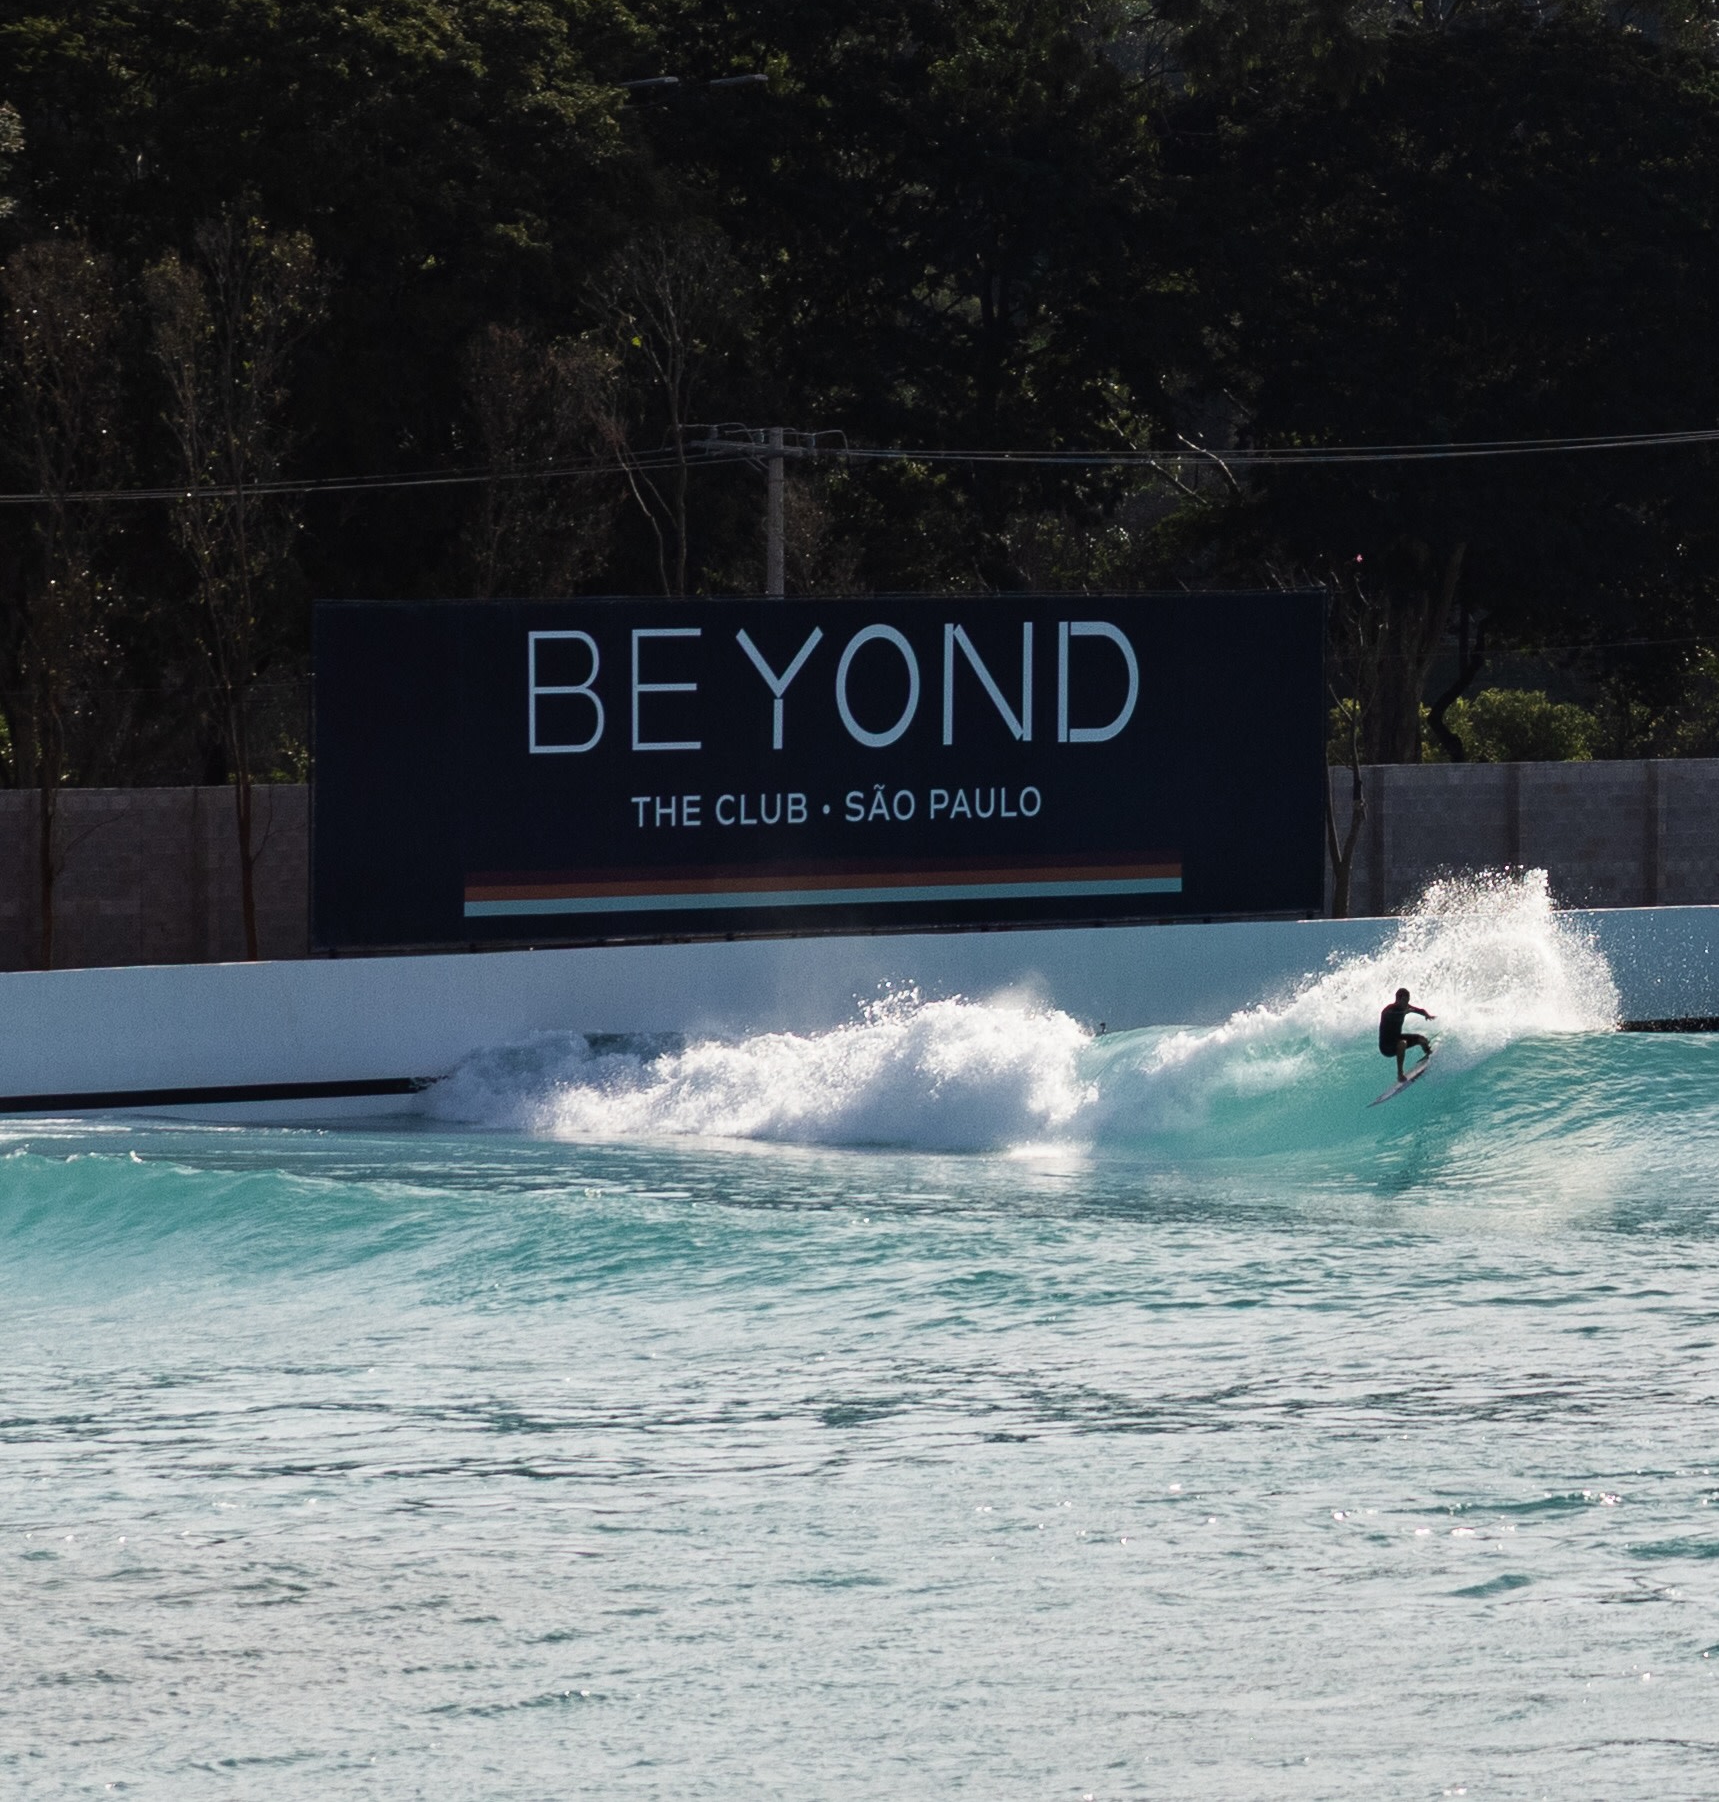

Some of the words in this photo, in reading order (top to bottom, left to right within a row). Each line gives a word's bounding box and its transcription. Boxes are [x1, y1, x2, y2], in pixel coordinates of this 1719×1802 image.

[527, 621, 1139, 754] BEYOND
[630, 795, 702, 828] THE
[715, 792, 808, 826] CLUB
[845, 783, 916, 822] SÃO
[930, 786, 1042, 820] PAULO
